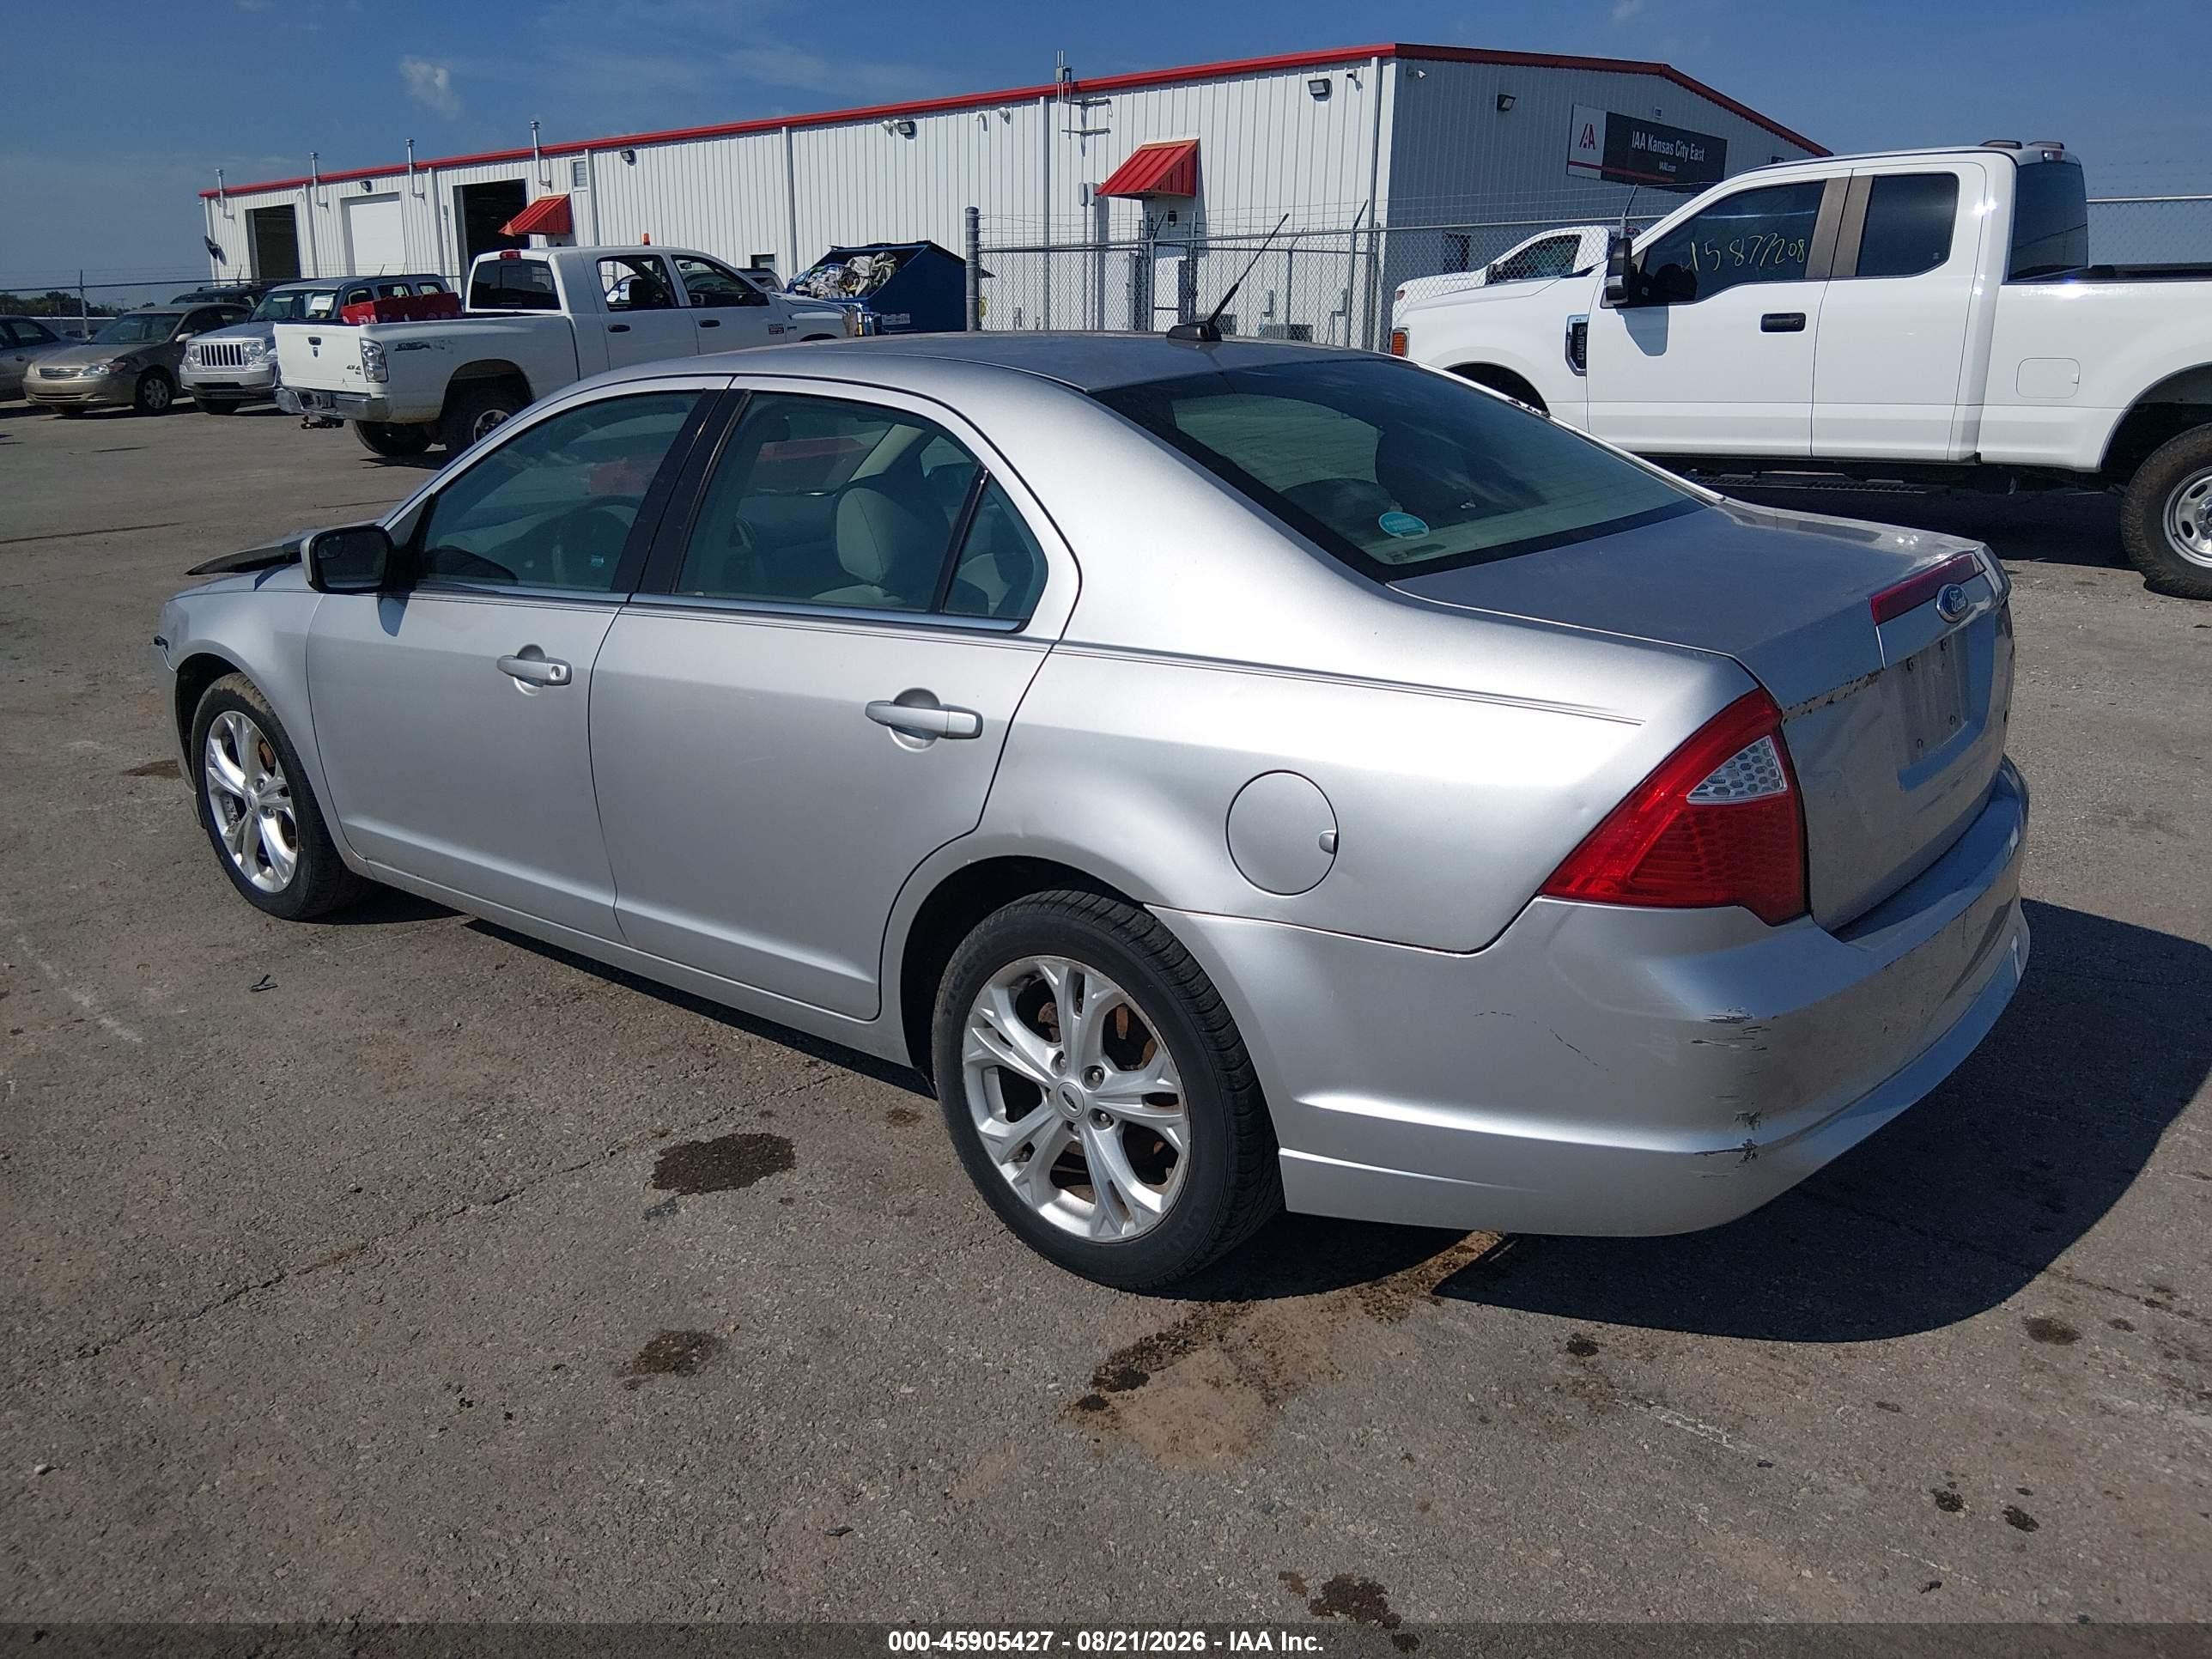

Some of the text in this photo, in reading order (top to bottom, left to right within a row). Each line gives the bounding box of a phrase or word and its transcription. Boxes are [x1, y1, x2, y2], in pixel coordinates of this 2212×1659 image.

[1632, 131, 1705, 162] IAA Kansas City East
